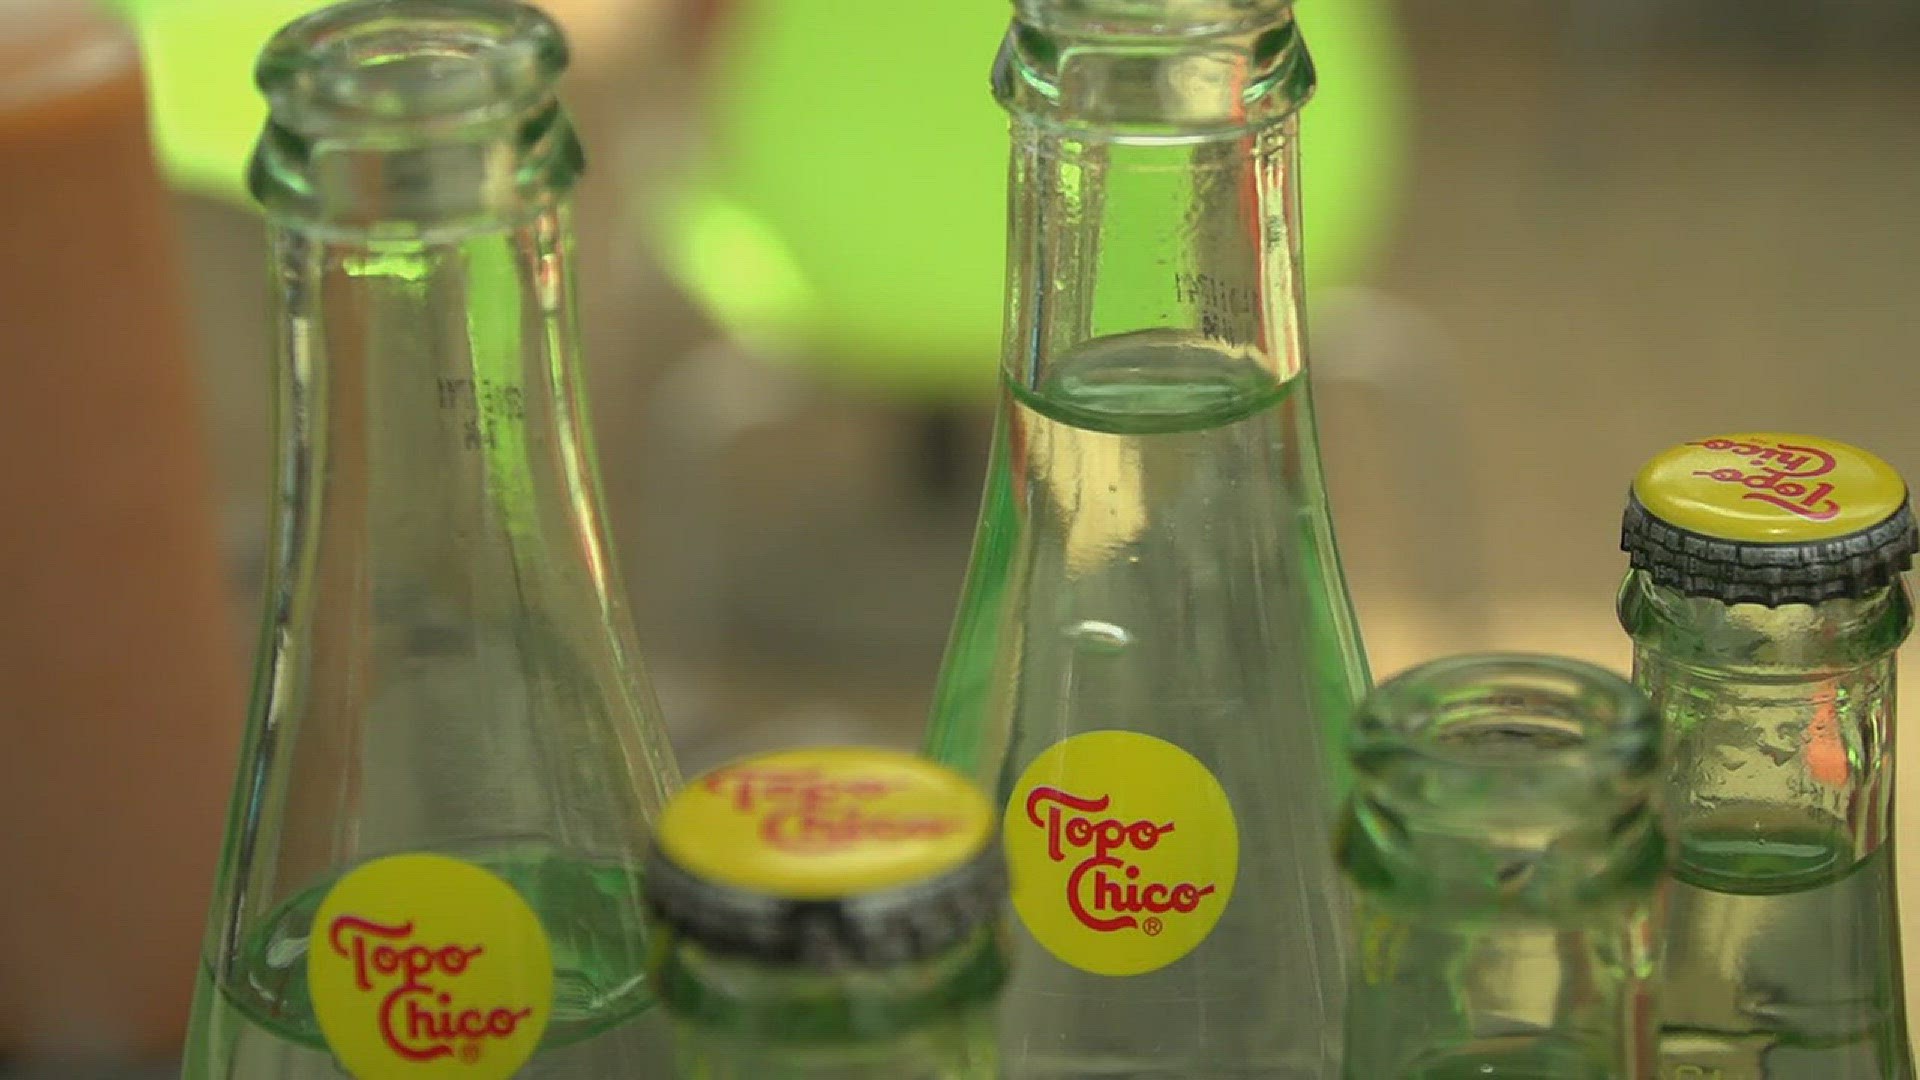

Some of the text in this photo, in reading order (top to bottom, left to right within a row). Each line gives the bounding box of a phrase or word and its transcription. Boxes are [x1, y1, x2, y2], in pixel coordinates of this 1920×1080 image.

[1684, 439, 1837, 478] Chico
[1692, 466, 1841, 521] Topo
[1026, 786, 1176, 862] Topo
[1066, 856, 1216, 933] Chico
[328, 914, 485, 992] Topo
[377, 985, 534, 1062] Chico
